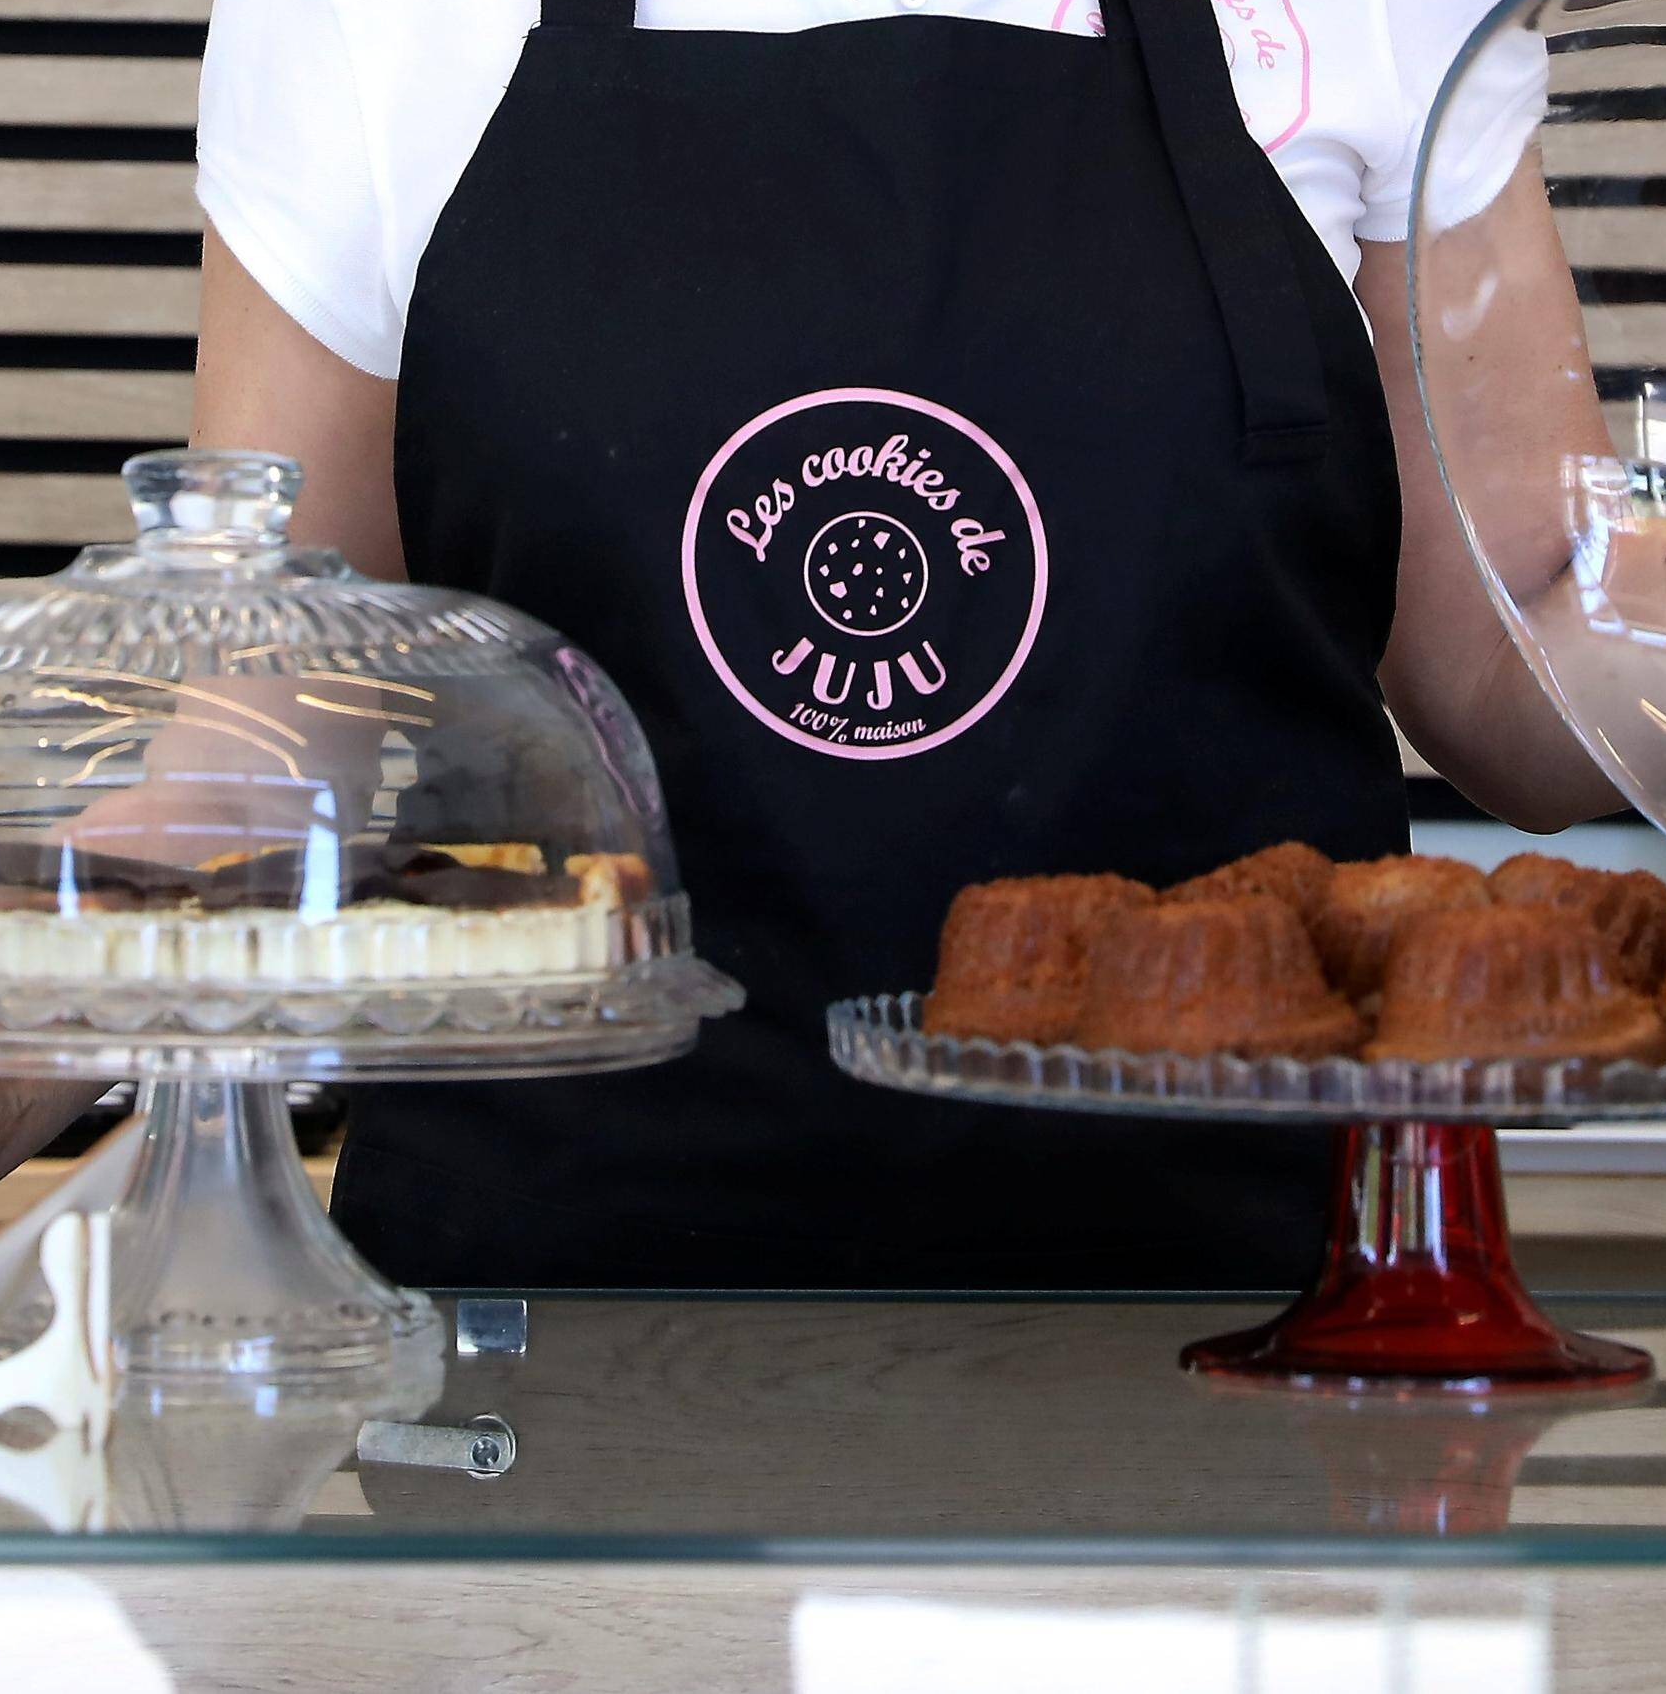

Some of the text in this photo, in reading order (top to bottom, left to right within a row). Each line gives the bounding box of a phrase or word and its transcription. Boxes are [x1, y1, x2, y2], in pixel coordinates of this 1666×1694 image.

[1250, 29, 1287, 70] de
[726, 434, 1007, 577] Les cookies de
[771, 636, 947, 711] JUJU
[788, 702, 927, 744] 100% maison
